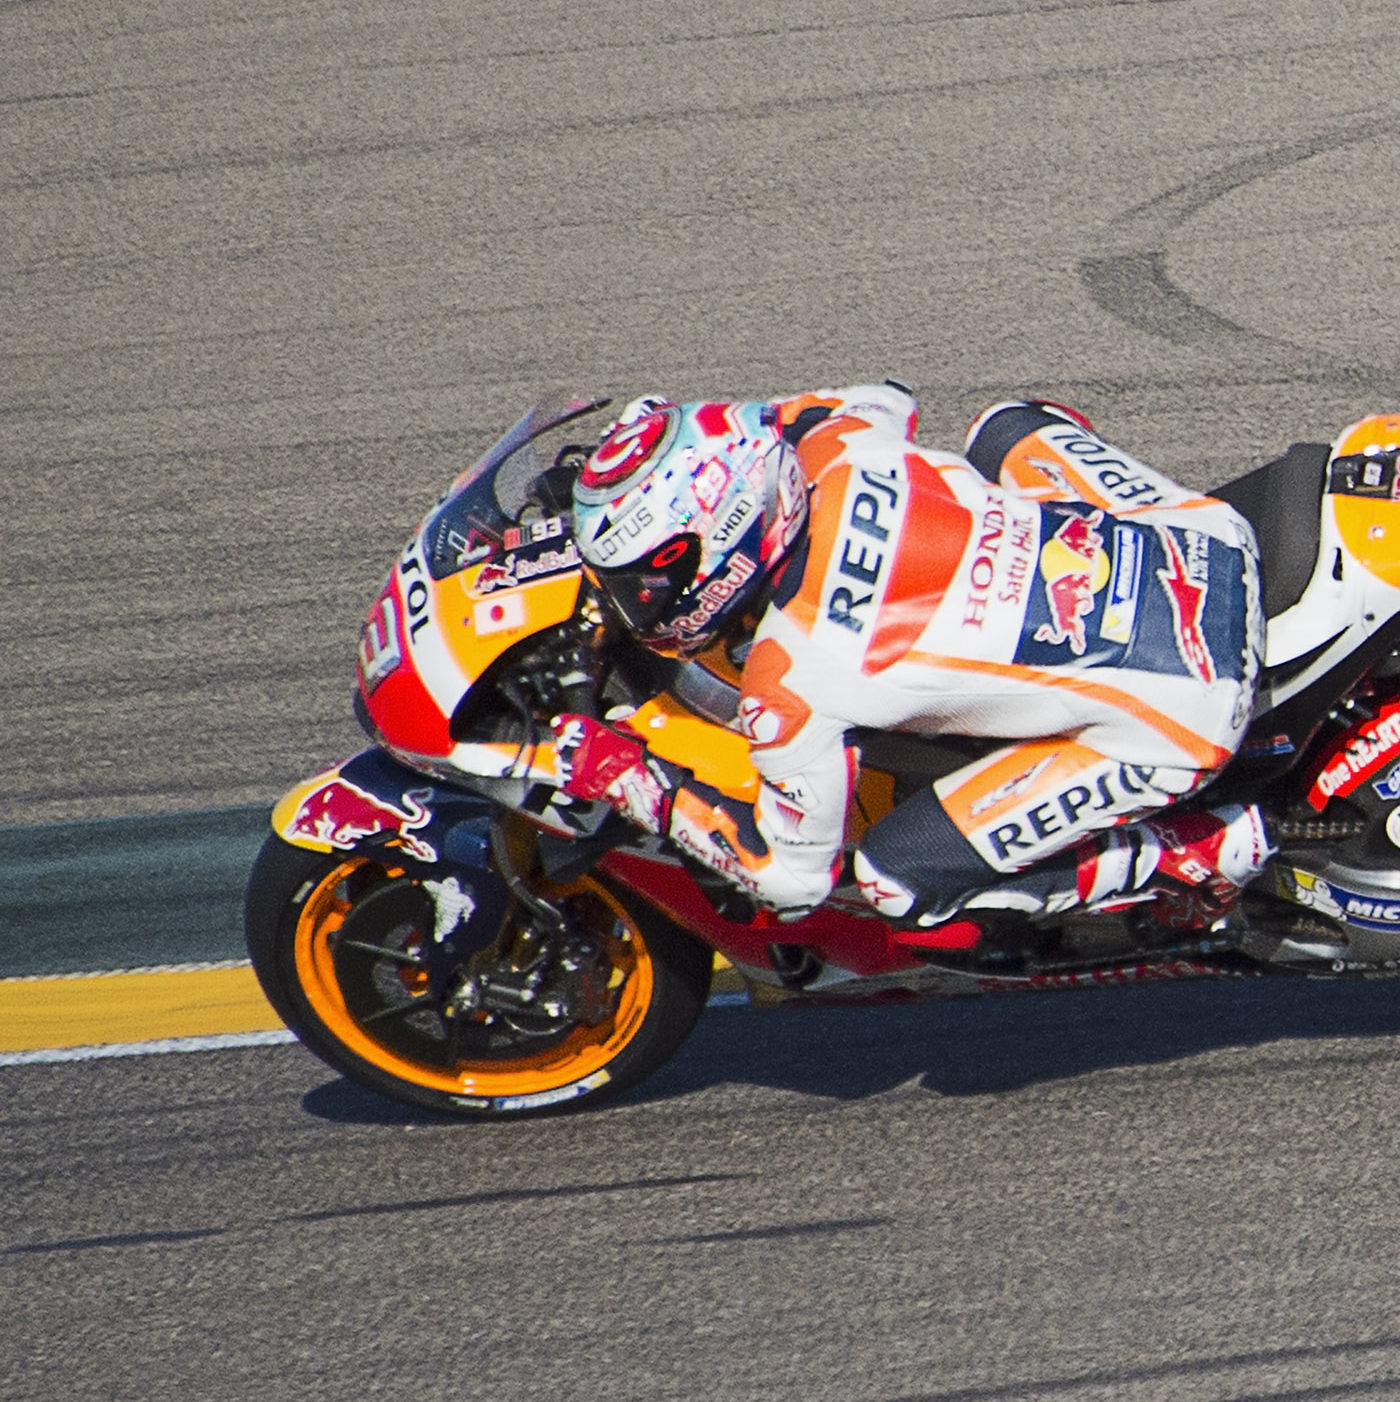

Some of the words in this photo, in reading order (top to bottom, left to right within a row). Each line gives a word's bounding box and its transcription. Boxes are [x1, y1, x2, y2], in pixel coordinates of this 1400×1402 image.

[531, 516, 563, 542] 93
[594, 506, 654, 562] LOTUS
[712, 498, 753, 547] SHOEI
[826, 468, 898, 635] REPS
[1317, 762, 1352, 797] One
